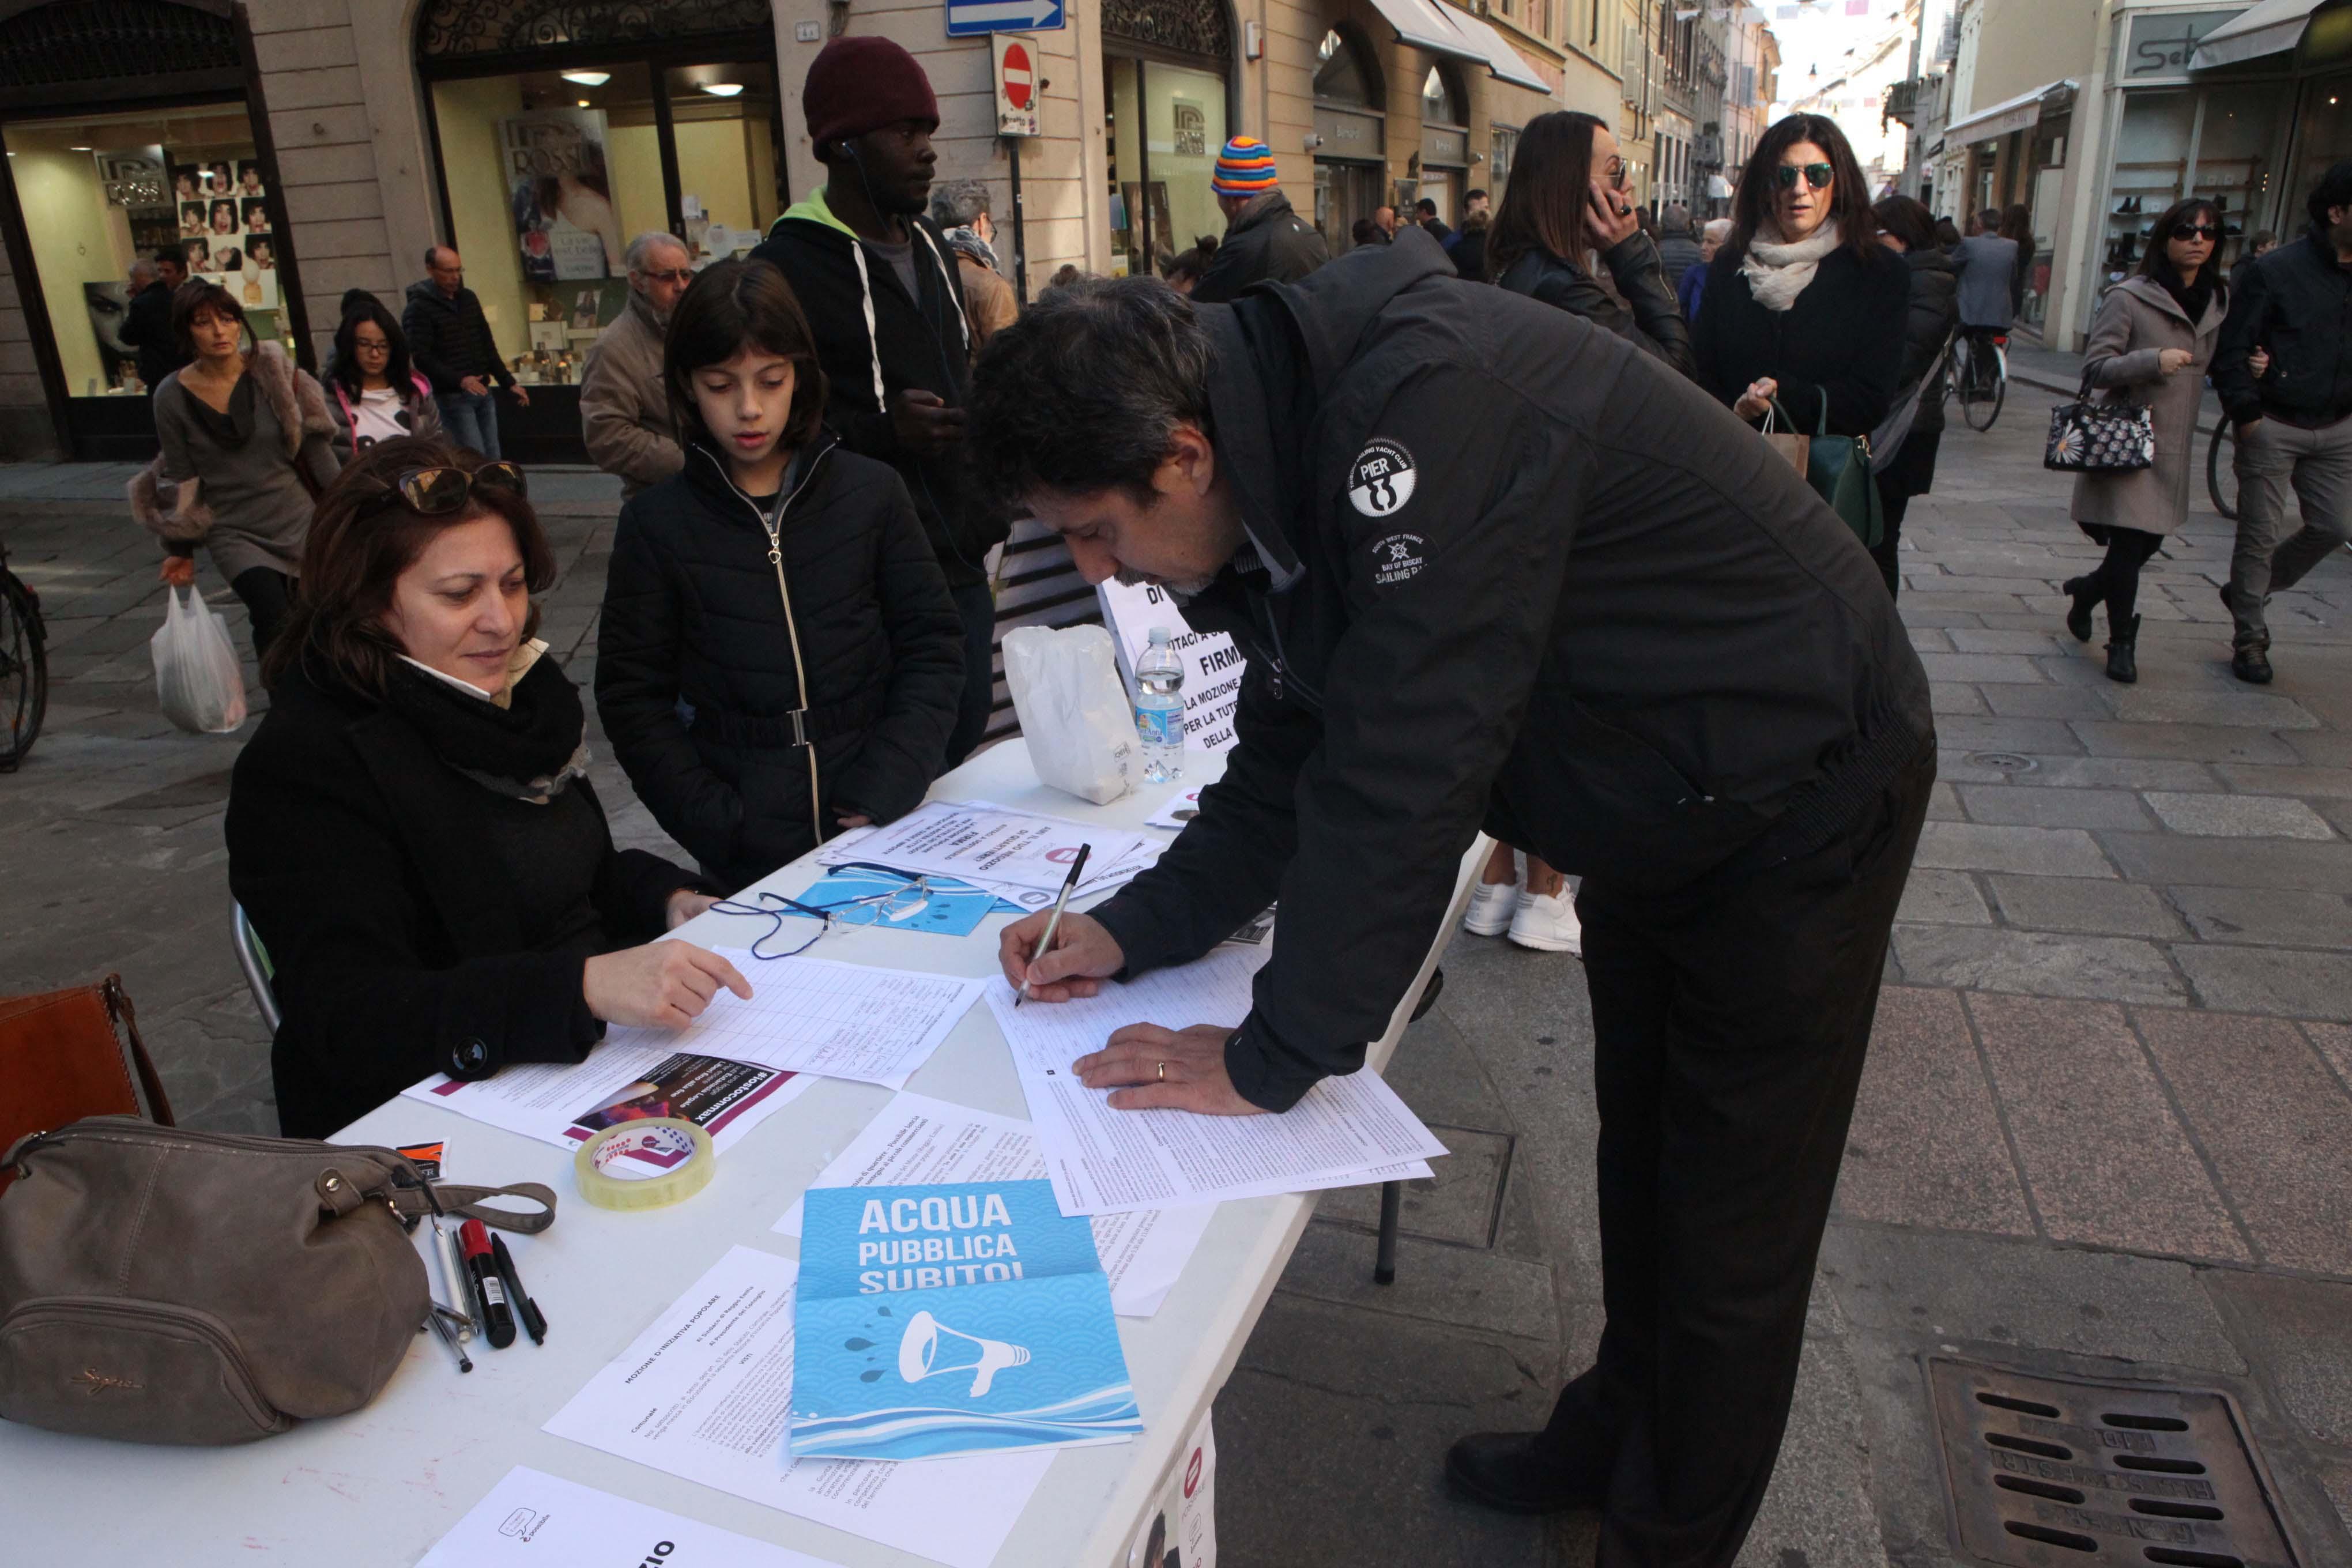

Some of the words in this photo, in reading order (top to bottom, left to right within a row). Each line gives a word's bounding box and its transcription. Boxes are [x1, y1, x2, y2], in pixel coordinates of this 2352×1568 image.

[1376, 447, 1395, 457] YACHT
[1395, 454, 1407, 470] CLUB
[1360, 458, 1390, 481] PIER
[1372, 540, 1386, 553] SOUTH
[1385, 534, 1401, 542] WEST
[1403, 534, 1424, 545] FRANCE
[1382, 563, 1393, 572] BAY
[1393, 561, 1401, 569] OF
[1401, 556, 1423, 568] BISCAY
[1375, 568, 1410, 584] SAILING
[1147, 586, 1164, 605] DI
[1184, 696, 1197, 711] LA
[1198, 677, 1239, 705] MOZIONE
[1183, 717, 1204, 735] PER
[1203, 711, 1216, 729] LA
[1203, 727, 1232, 749] DELLA
[948, 831, 978, 846] FIRMA
[971, 835, 1019, 861] QUARTIERE?
[1009, 840, 1030, 850] TUO
[977, 850, 1013, 870] NEGOZIO
[693, 1072, 708, 1080] fino
[700, 1070, 723, 1084] essere
[704, 1061, 725, 1073] Liberi
[668, 1088, 684, 1097] fine
[681, 1080, 698, 1088] alla
[708, 1083, 730, 1095] legge
[677, 1092, 704, 1108] Legale
[693, 1071, 768, 1121] #iostoconmax
[865, 1166, 885, 1186] sostegno
[886, 1147, 903, 1162] piccoli
[899, 1118, 929, 1148] commercianti
[866, 1151, 888, 1171] quartiere
[887, 1128, 908, 1148] Possibile
[905, 1115, 920, 1129] lancia
[859, 1194, 1012, 1234] ACQUA
[859, 1234, 1017, 1266] PUBBLICA
[859, 1261, 1023, 1294] SUBITO!
[701, 1319, 722, 1336] Sindaco
[724, 1299, 742, 1313] Reggio
[738, 1286, 755, 1299] Emilia
[713, 1316, 741, 1340] Presidente
[744, 1290, 767, 1309] Consiglio
[625, 1356, 657, 1384] MOZIONE
[654, 1323, 692, 1356] D'INIZIATIVA
[688, 1294, 722, 1322] POPOLARE
[738, 1353, 754, 1365] VISTI
[631, 1408, 657, 1433] Comunale
[751, 1426, 771, 1445] sviluppo
[529, 1515, 551, 1536] possibile
